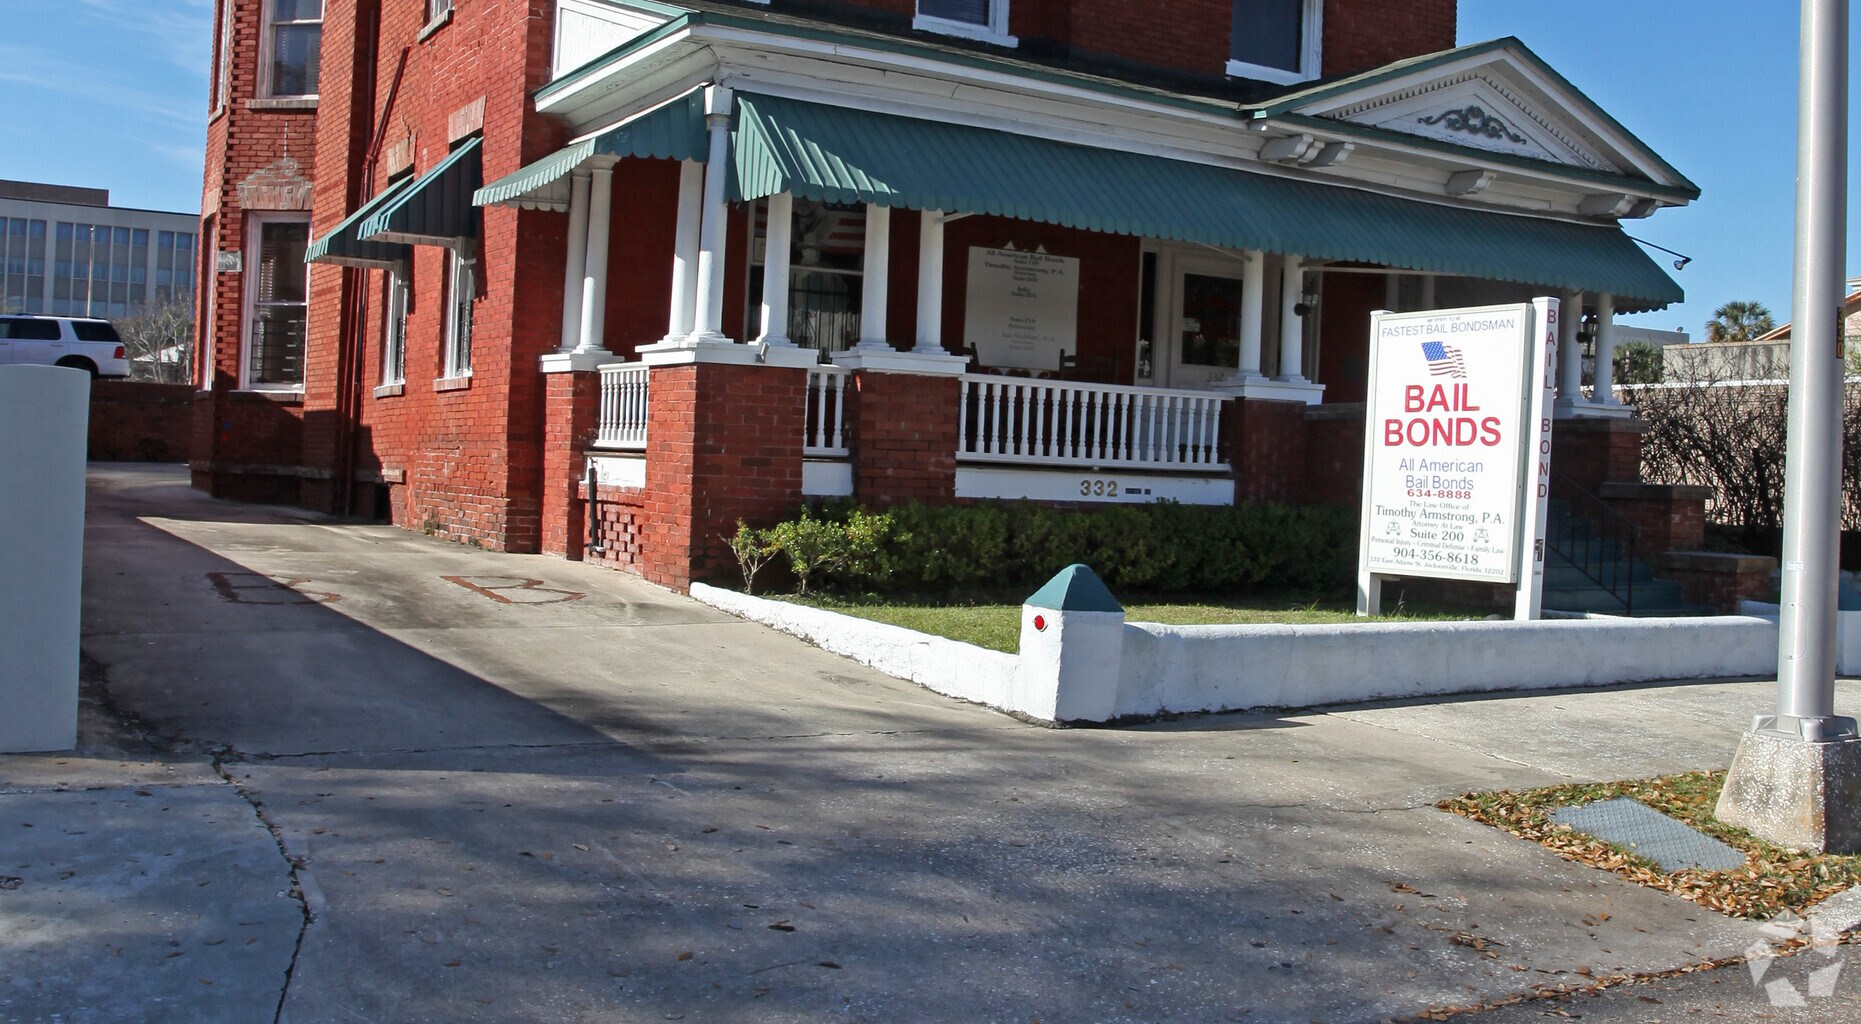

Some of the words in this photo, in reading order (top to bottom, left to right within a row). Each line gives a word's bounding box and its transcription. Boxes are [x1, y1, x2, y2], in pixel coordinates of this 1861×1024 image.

[1382, 324, 1425, 337] FASTEST
[1426, 323, 1447, 335] BAIL
[1451, 319, 1514, 333] BONDSMAN
[1545, 309, 1557, 389] BAIL
[1405, 383, 1480, 413] BAIL
[1385, 417, 1501, 447] BONDS
[1399, 458, 1414, 471] All
[1419, 458, 1483, 472] American
[1537, 418, 1551, 498] BOND
[1080, 480, 1118, 497] 332
[1406, 475, 1428, 488] Bail
[1433, 476, 1474, 490] Bonds
[1407, 489, 1471, 499] 634-8888
[1376, 505, 1416, 519] Timothy
[1420, 509, 1477, 524] Armstrong,
[1482, 512, 1504, 524] P.A.
[1440, 502, 1460, 510] Office
[1412, 520, 1438, 529] Attorney
[1410, 528, 1437, 539] Suite
[1442, 531, 1464, 542] 200
[1371, 536, 1395, 544] Personal
[1396, 538, 1411, 546] Injury
[1417, 541, 1441, 549] Criminal
[1471, 545, 1490, 554] Family
[1492, 546, 1504, 554] Law
[1394, 547, 1478, 565] 904-356-8618
[1461, 564, 1482, 573] Florida
[1485, 567, 1504, 575] 32202
